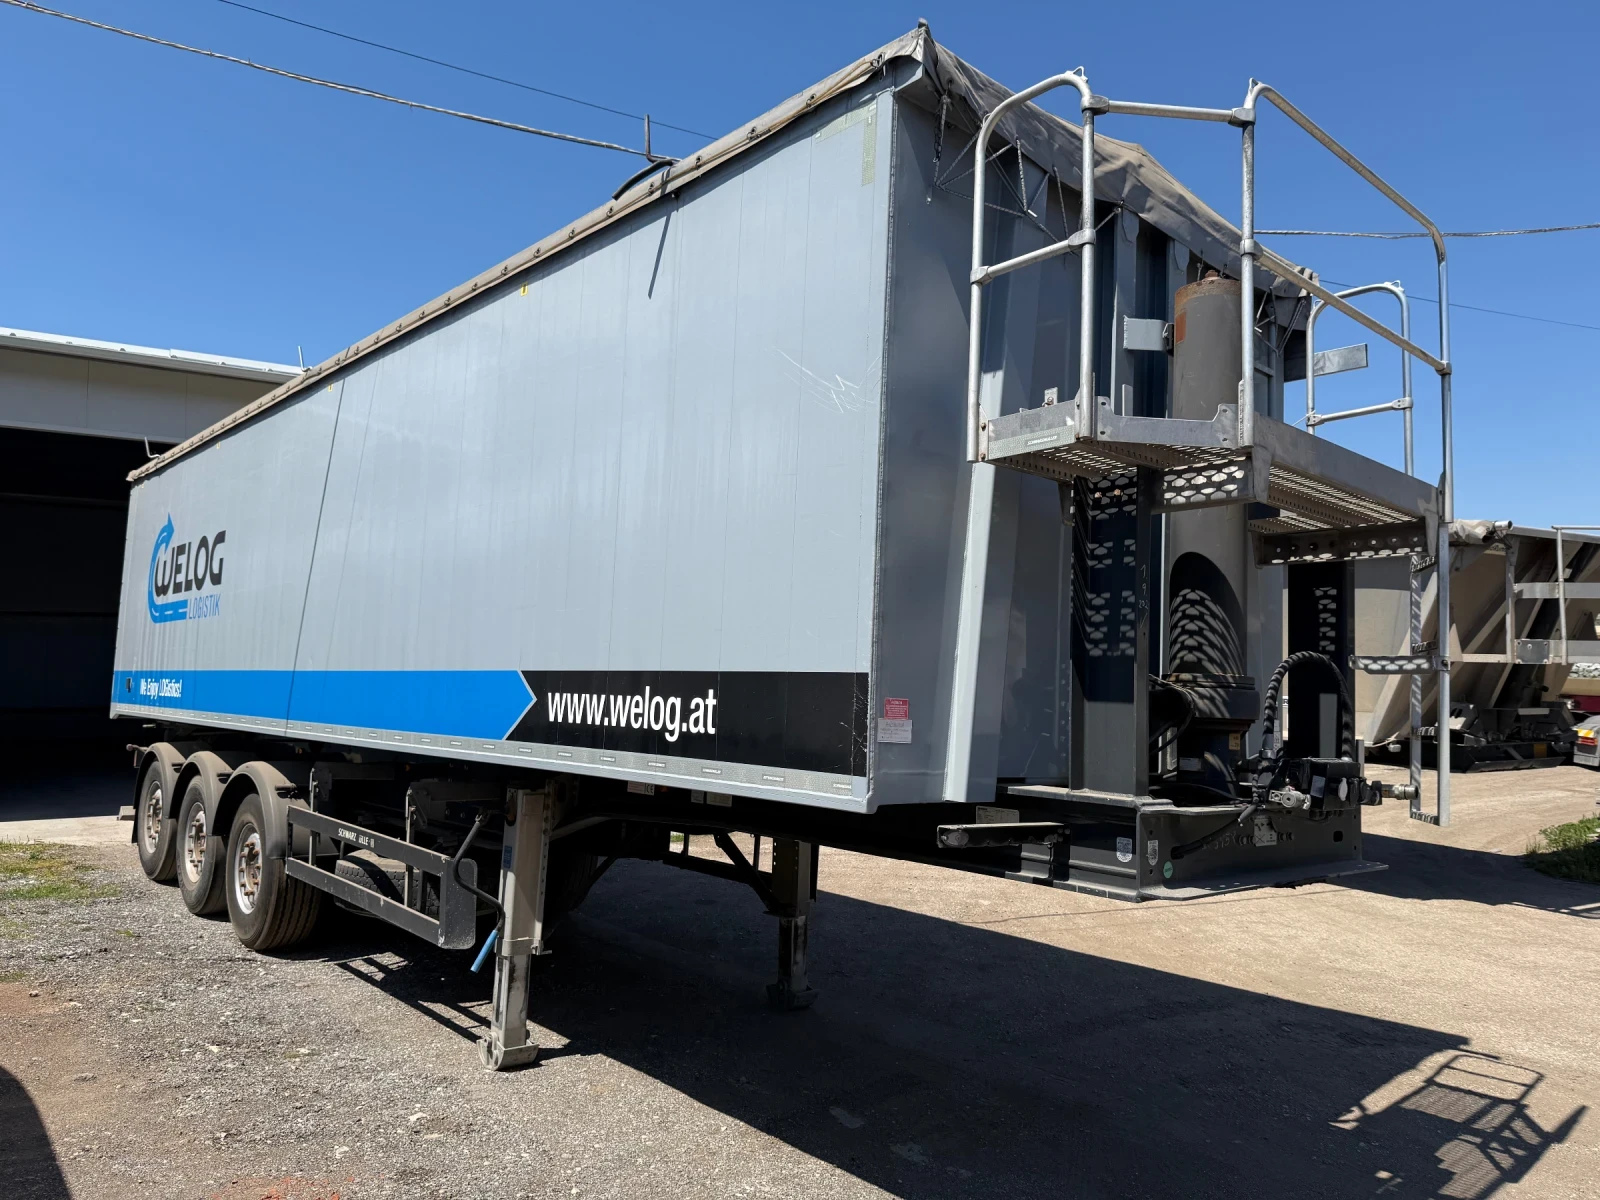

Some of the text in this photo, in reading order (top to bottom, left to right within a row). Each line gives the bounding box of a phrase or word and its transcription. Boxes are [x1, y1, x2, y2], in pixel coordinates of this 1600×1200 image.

[154, 530, 226, 598] WELOG
[188, 593, 222, 619] LOGISTIK
[140, 678, 147, 696] We
[146, 678, 160, 700] Enjoy
[547, 685, 717, 742] www.welog.at
